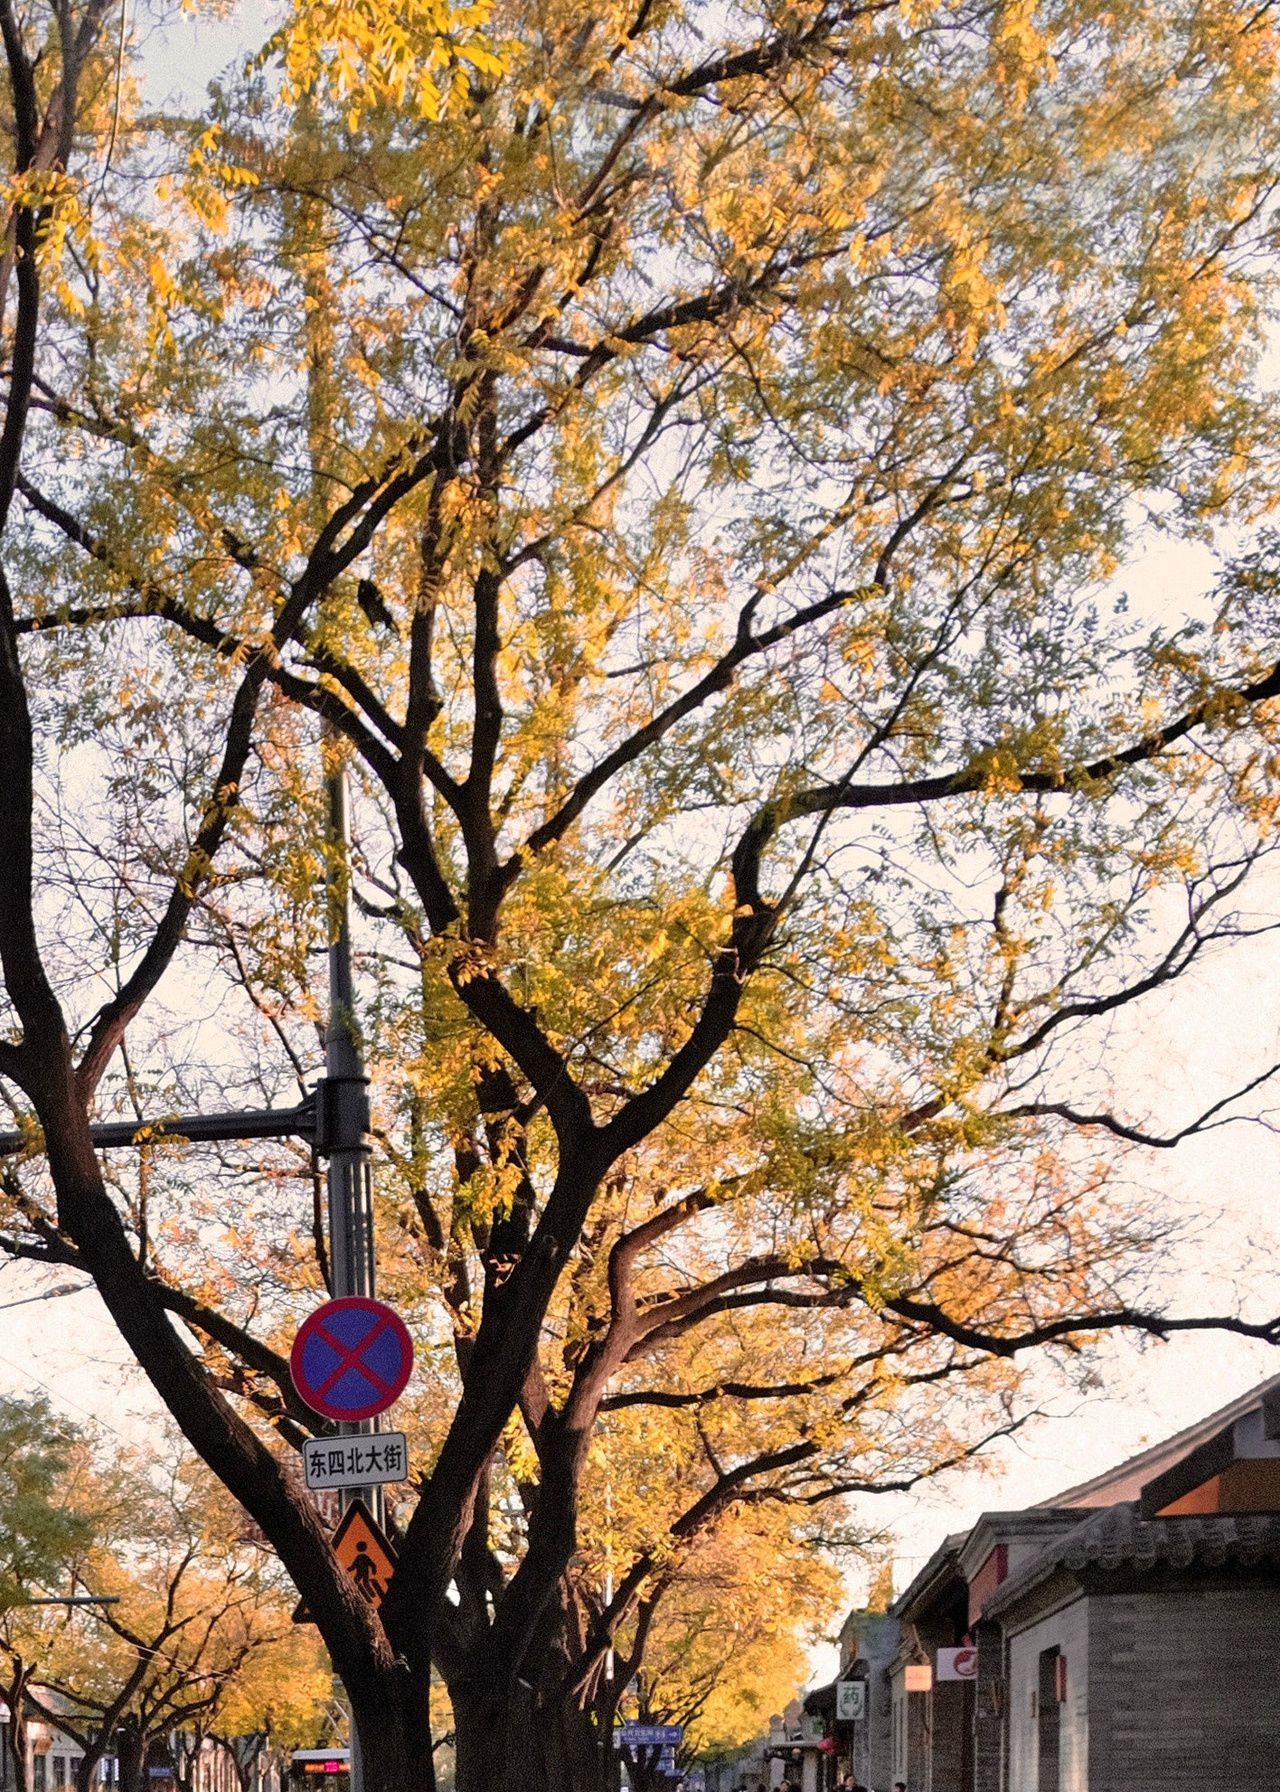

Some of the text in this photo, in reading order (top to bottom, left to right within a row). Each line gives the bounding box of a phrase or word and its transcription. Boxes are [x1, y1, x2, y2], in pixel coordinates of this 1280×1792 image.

[309, 1445, 402, 1478] 东四北大街
[843, 1685, 860, 1705] 药
